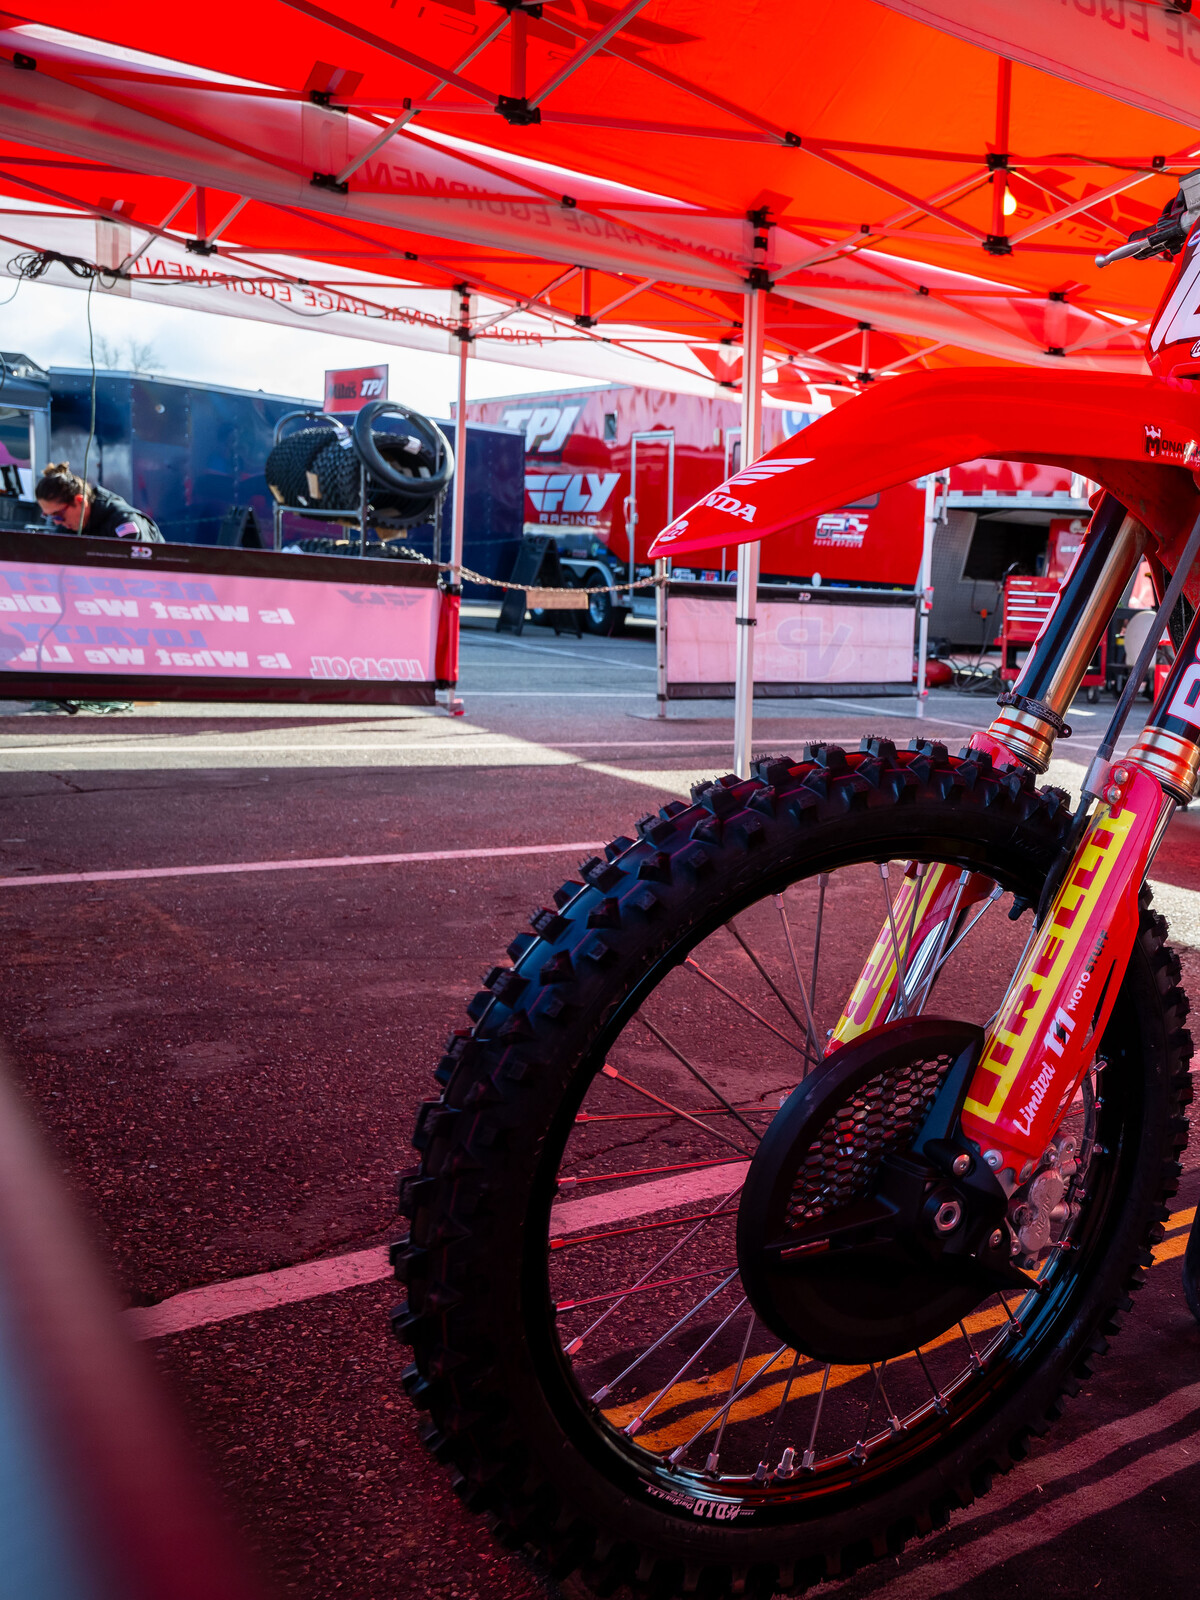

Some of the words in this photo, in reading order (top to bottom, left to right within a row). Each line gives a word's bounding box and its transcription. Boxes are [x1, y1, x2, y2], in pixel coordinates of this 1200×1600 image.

[360, 378, 385, 397] TPJ
[502, 405, 581, 452] TPJ
[525, 473, 622, 512] FLY
[699, 494, 757, 523] NDA
[538, 513, 598, 526] RACING
[1012, 1061, 1056, 1137] Limited
[1068, 930, 1110, 1012] MOTOSTUFF
